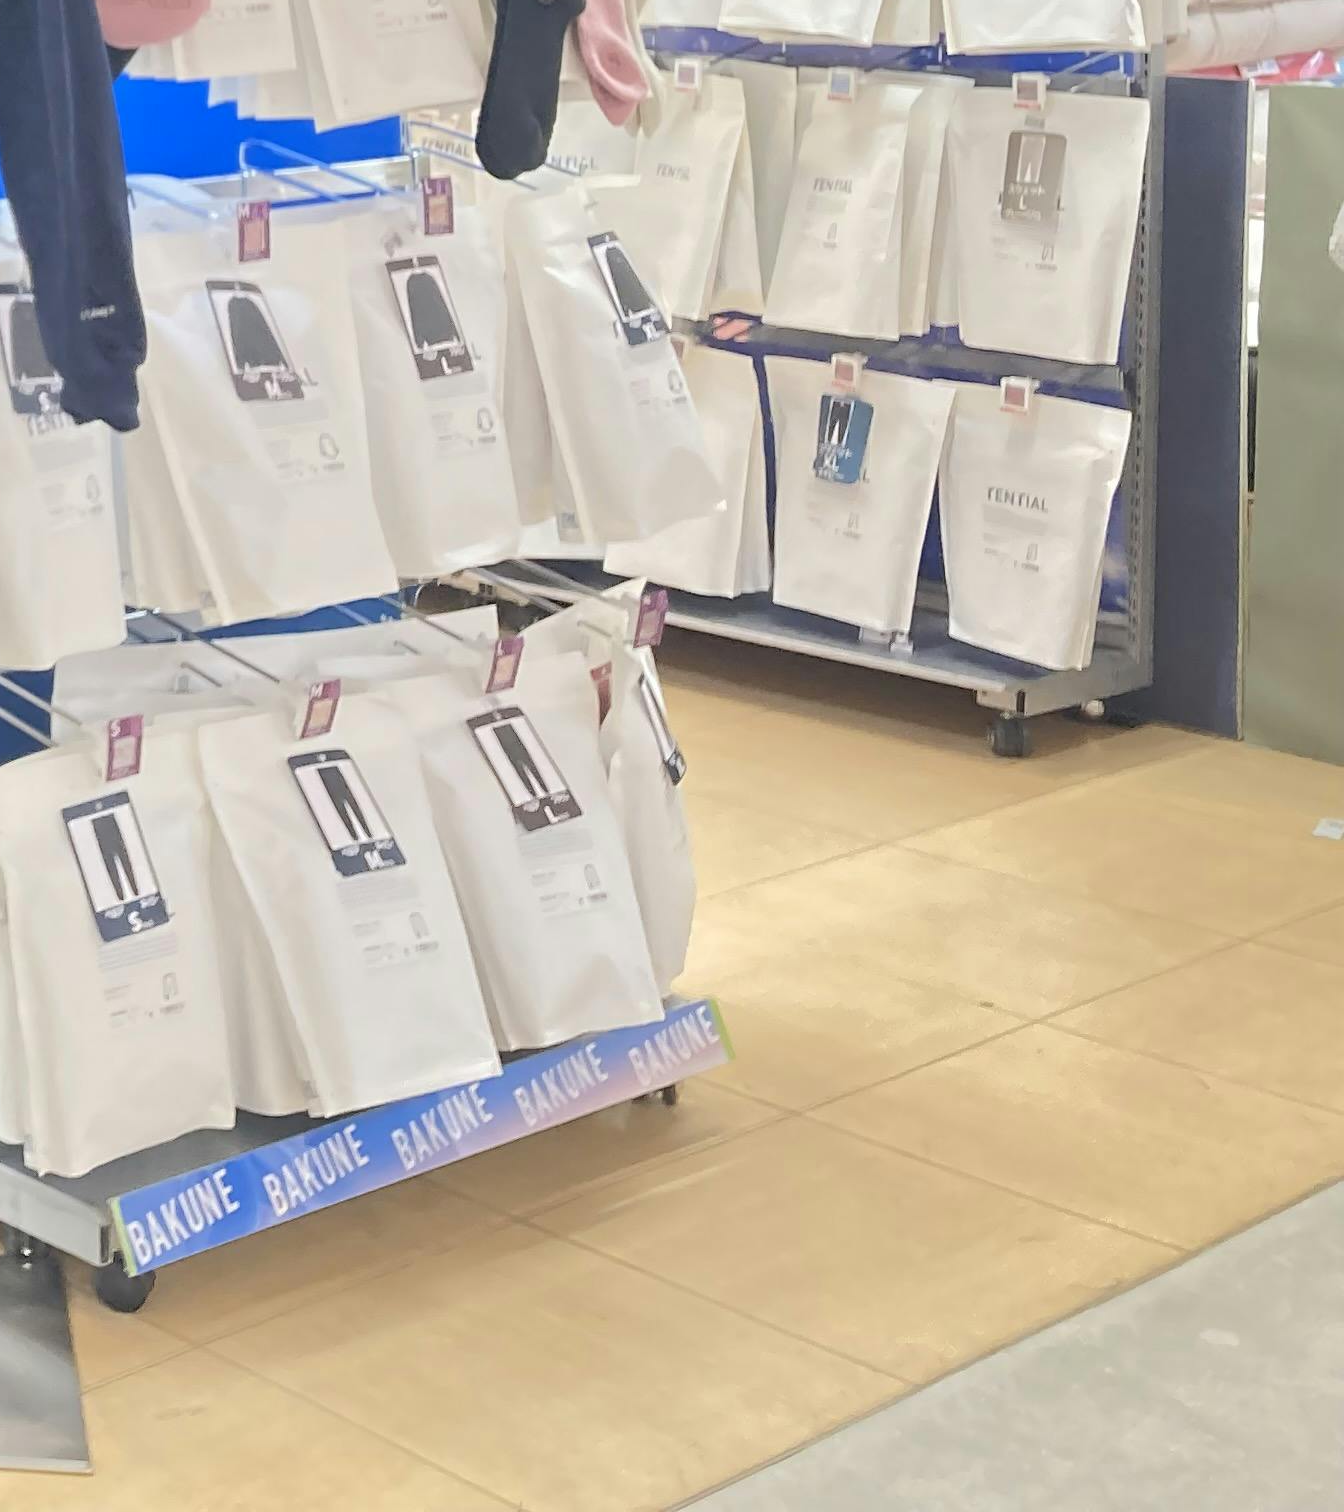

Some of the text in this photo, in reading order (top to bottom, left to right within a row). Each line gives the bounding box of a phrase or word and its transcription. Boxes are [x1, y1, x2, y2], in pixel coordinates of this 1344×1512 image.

[440, 355, 453, 376] L
[987, 487, 1050, 514] TENTIAL
[543, 804, 559, 825] L
[363, 849, 385, 871] M
[127, 911, 144, 934] S
[126, 1005, 722, 1268] BAKUNE BAKUNE BAKUNE BAKUNE BAKUNE
